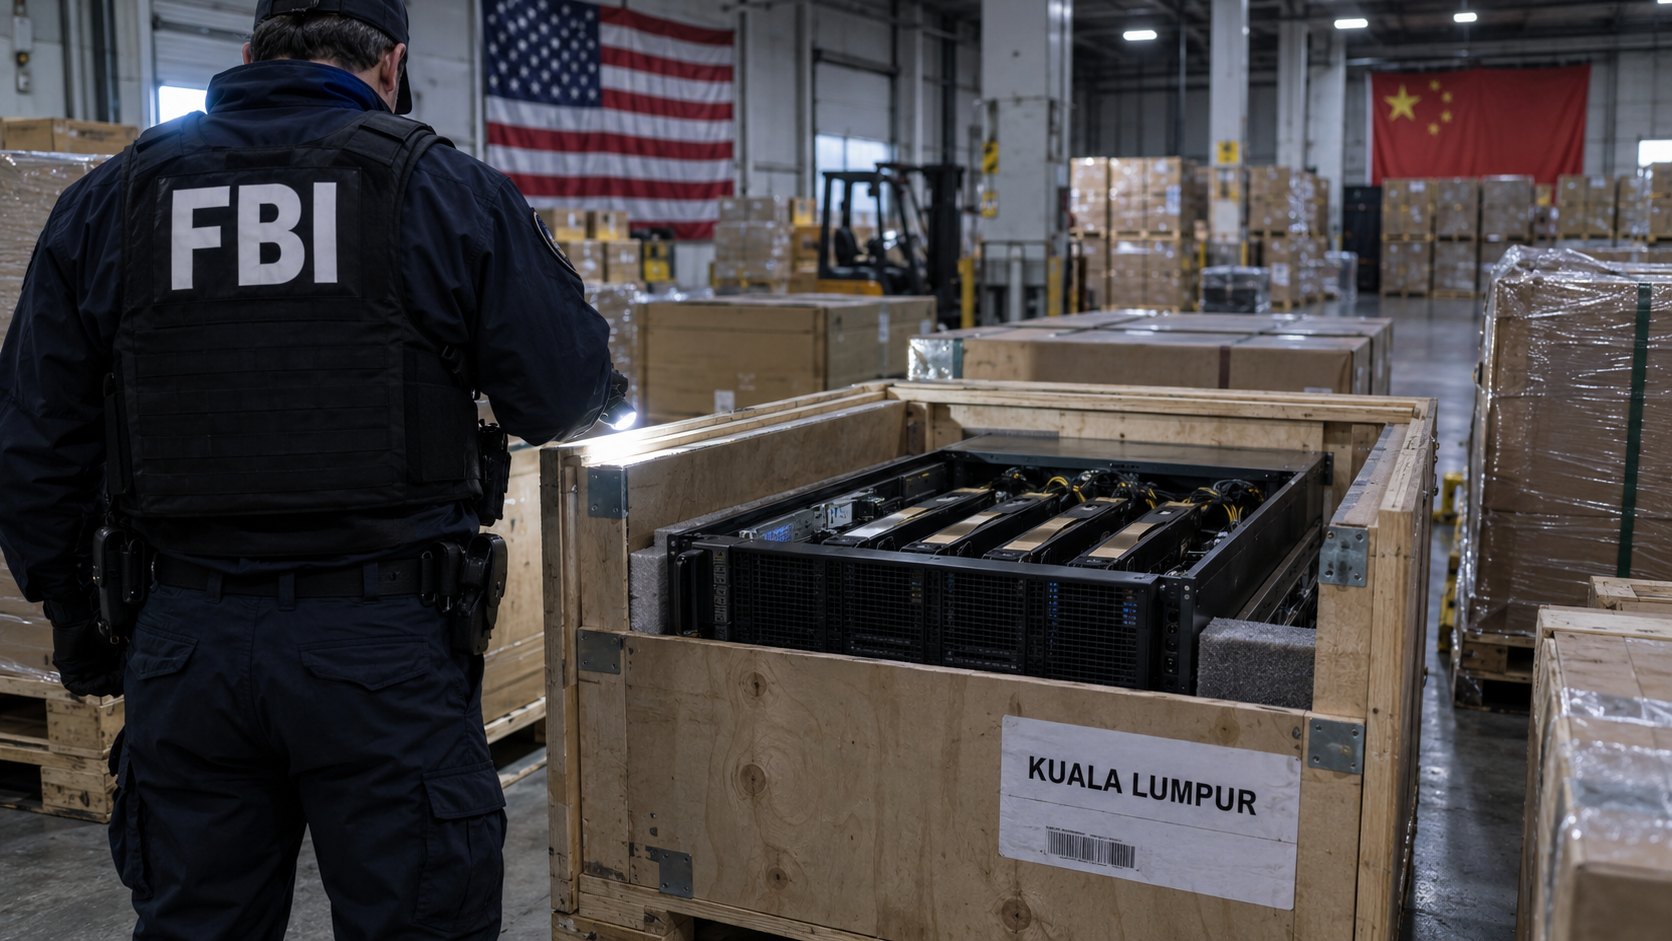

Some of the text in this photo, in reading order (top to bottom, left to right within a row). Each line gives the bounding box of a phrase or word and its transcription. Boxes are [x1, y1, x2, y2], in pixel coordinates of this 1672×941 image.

[171, 182, 338, 291] FBI
[1028, 755, 1257, 816] KUALA LUMPUR
